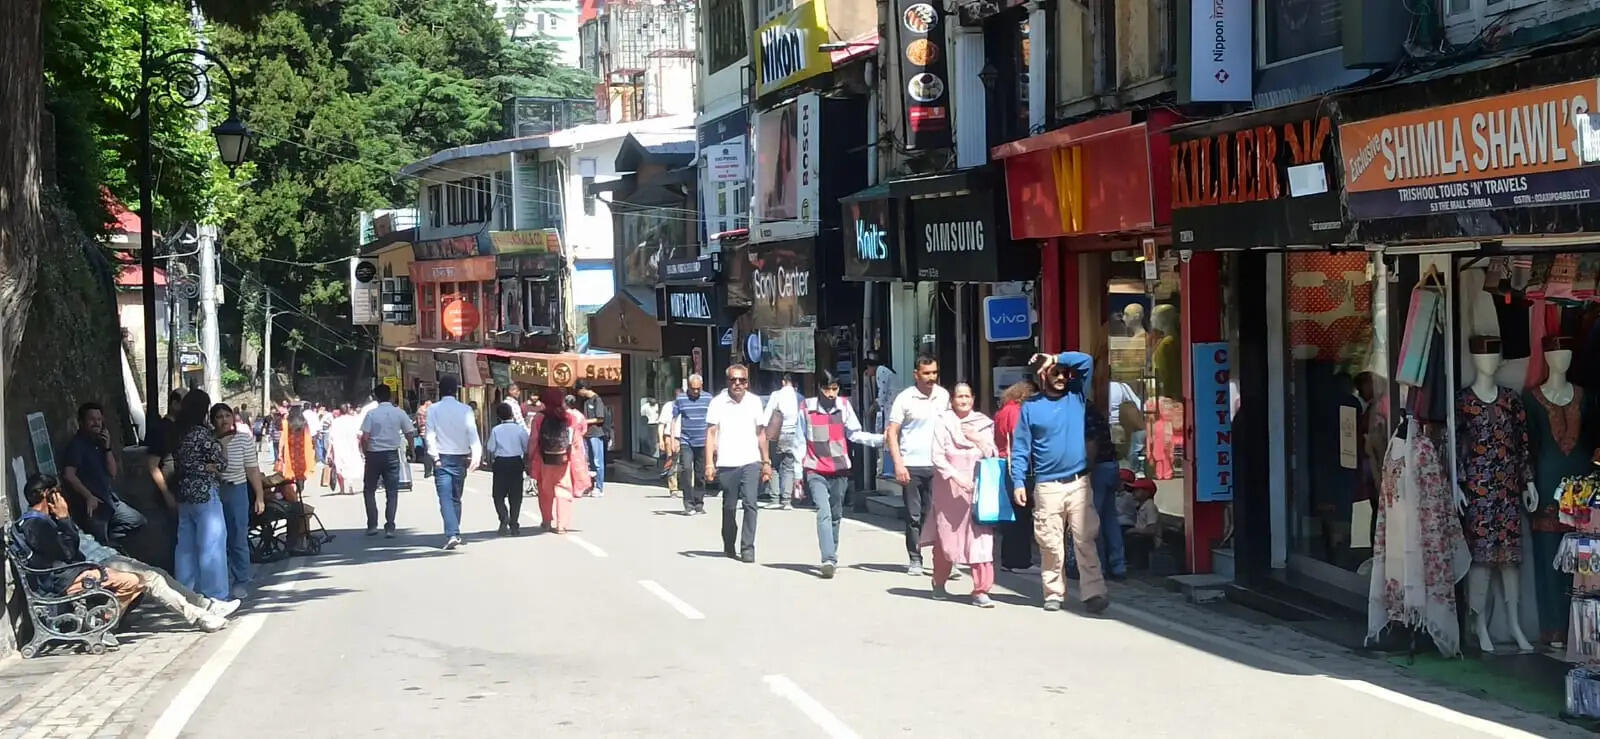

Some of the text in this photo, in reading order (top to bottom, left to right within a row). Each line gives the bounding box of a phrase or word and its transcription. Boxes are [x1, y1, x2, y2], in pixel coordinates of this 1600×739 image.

[761, 26, 806, 84] Nikon
[1213, 20, 1226, 62] Nippon
[1171, 125, 1280, 209] KILLER
[1350, 133, 1382, 184] Exclusive
[1380, 116, 1470, 182] SHIMLA
[1398, 187, 1439, 203] TRISHOOL
[1439, 182, 1469, 199] TOURS
[1484, 176, 1528, 195] TRAVELS
[1439, 201, 1450, 211] THE
[1450, 199, 1467, 210] MALL
[1467, 197, 1493, 209] SHIMLA
[856, 219, 888, 260] Knits
[925, 220, 984, 253] SAMSUNG
[754, 266, 809, 306] Sony Center
[992, 312, 1027, 325] vivo
[1214, 349, 1232, 486] COZYNET
